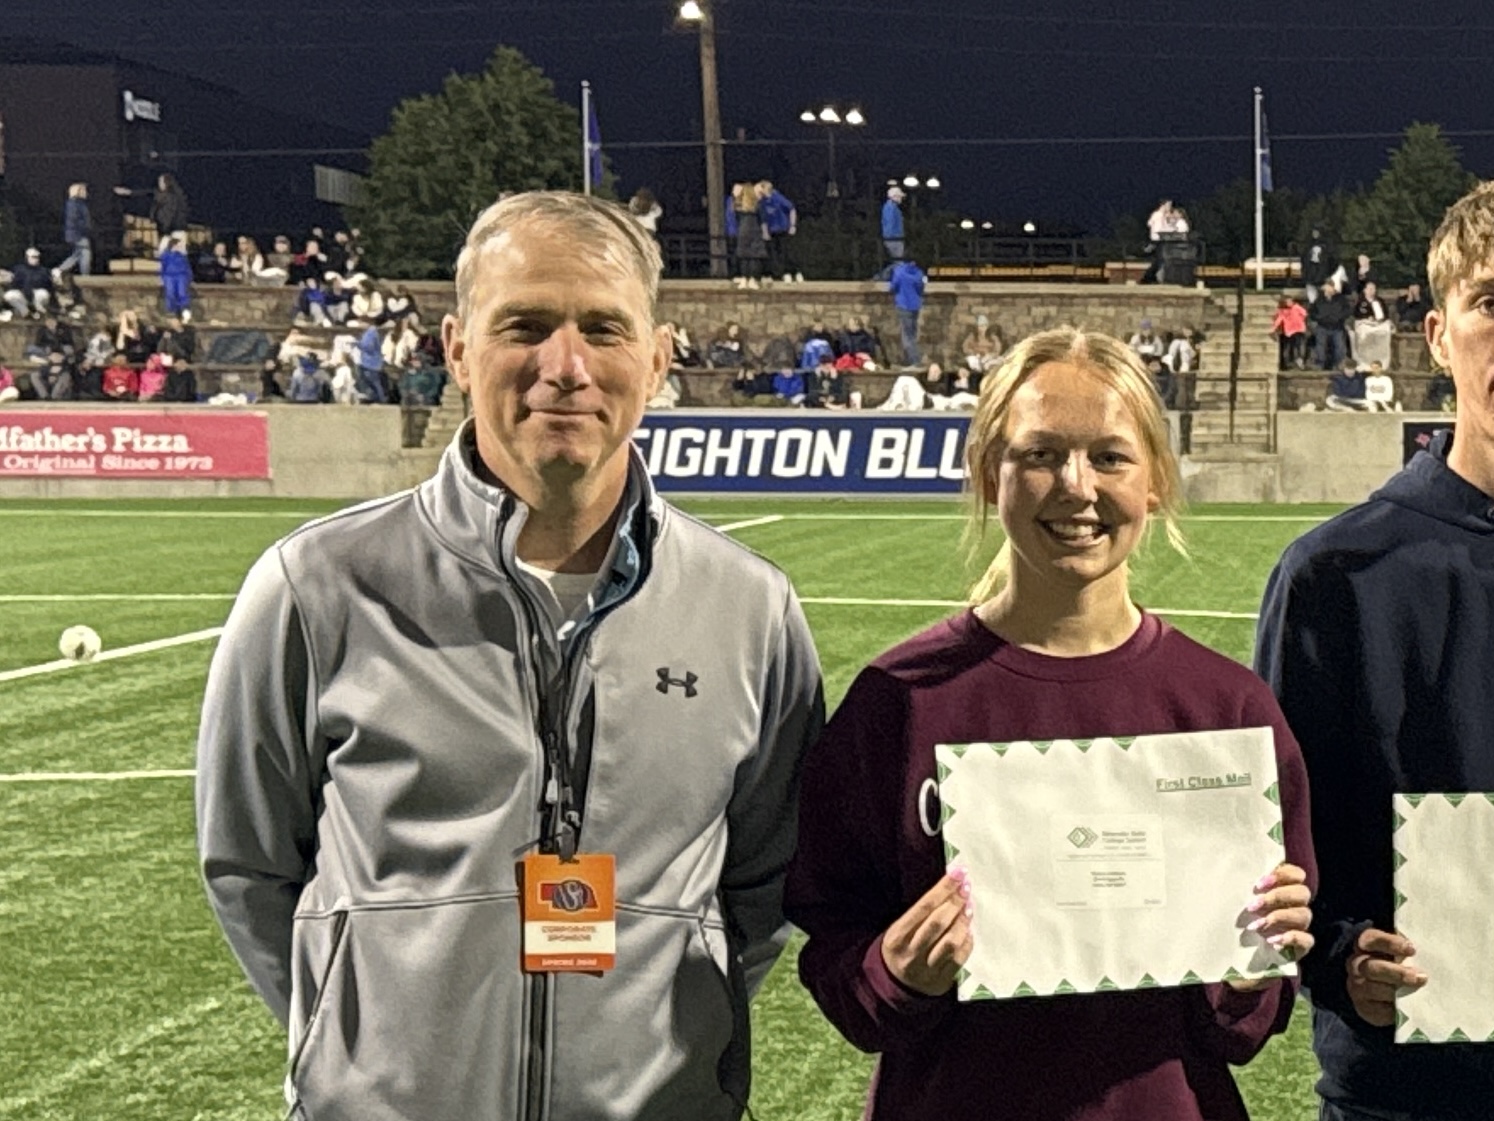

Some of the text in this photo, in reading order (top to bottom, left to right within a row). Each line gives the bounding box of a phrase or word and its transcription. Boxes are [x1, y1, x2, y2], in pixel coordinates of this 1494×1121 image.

[111, 427, 190, 452] Pizza
[3, 454, 95, 473] Original
[101, 455, 160, 470] Since
[1156, 773, 1251, 790] First Class Mail
